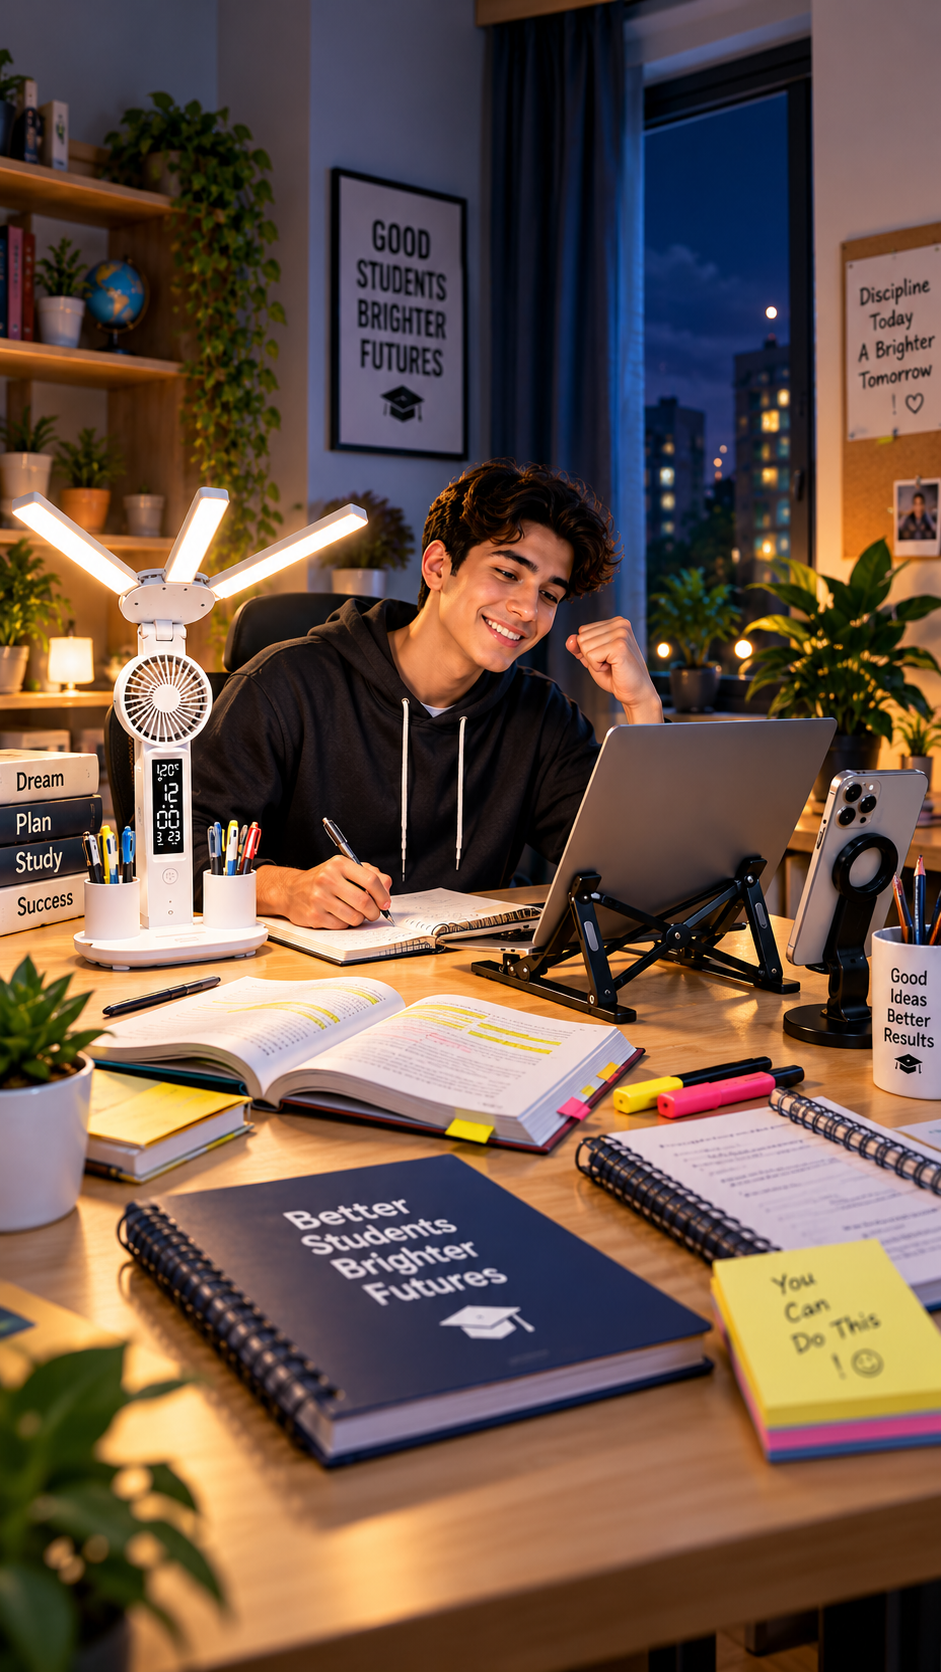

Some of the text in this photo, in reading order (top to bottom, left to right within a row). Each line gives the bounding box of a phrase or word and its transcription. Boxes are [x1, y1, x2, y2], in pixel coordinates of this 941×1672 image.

[372, 219, 431, 260] GOOD
[356, 259, 448, 302] STUDENTS
[859, 278, 931, 306] Discipline
[357, 299, 447, 341] BRIGHTER
[869, 310, 914, 331] Today
[360, 339, 444, 378] FUTURES
[858, 333, 936, 363] A Brighter
[858, 364, 933, 390] Tomorrow
[16, 771, 64, 792] Dream
[16, 811, 52, 835] Plan
[15, 847, 63, 873] Study
[17, 890, 73, 916] Success
[890, 967, 928, 986] Good
[890, 988, 927, 1007] Ideas
[887, 1008, 931, 1028] Better
[884, 1027, 935, 1048] Results
[283, 1198, 410, 1231] Better
[301, 1218, 458, 1255] Students
[330, 1241, 479, 1280] Brighter
[361, 1266, 508, 1306] Futures
[770, 1271, 816, 1296] You
[784, 1297, 830, 1324] Can
[790, 1311, 882, 1355] Do This
